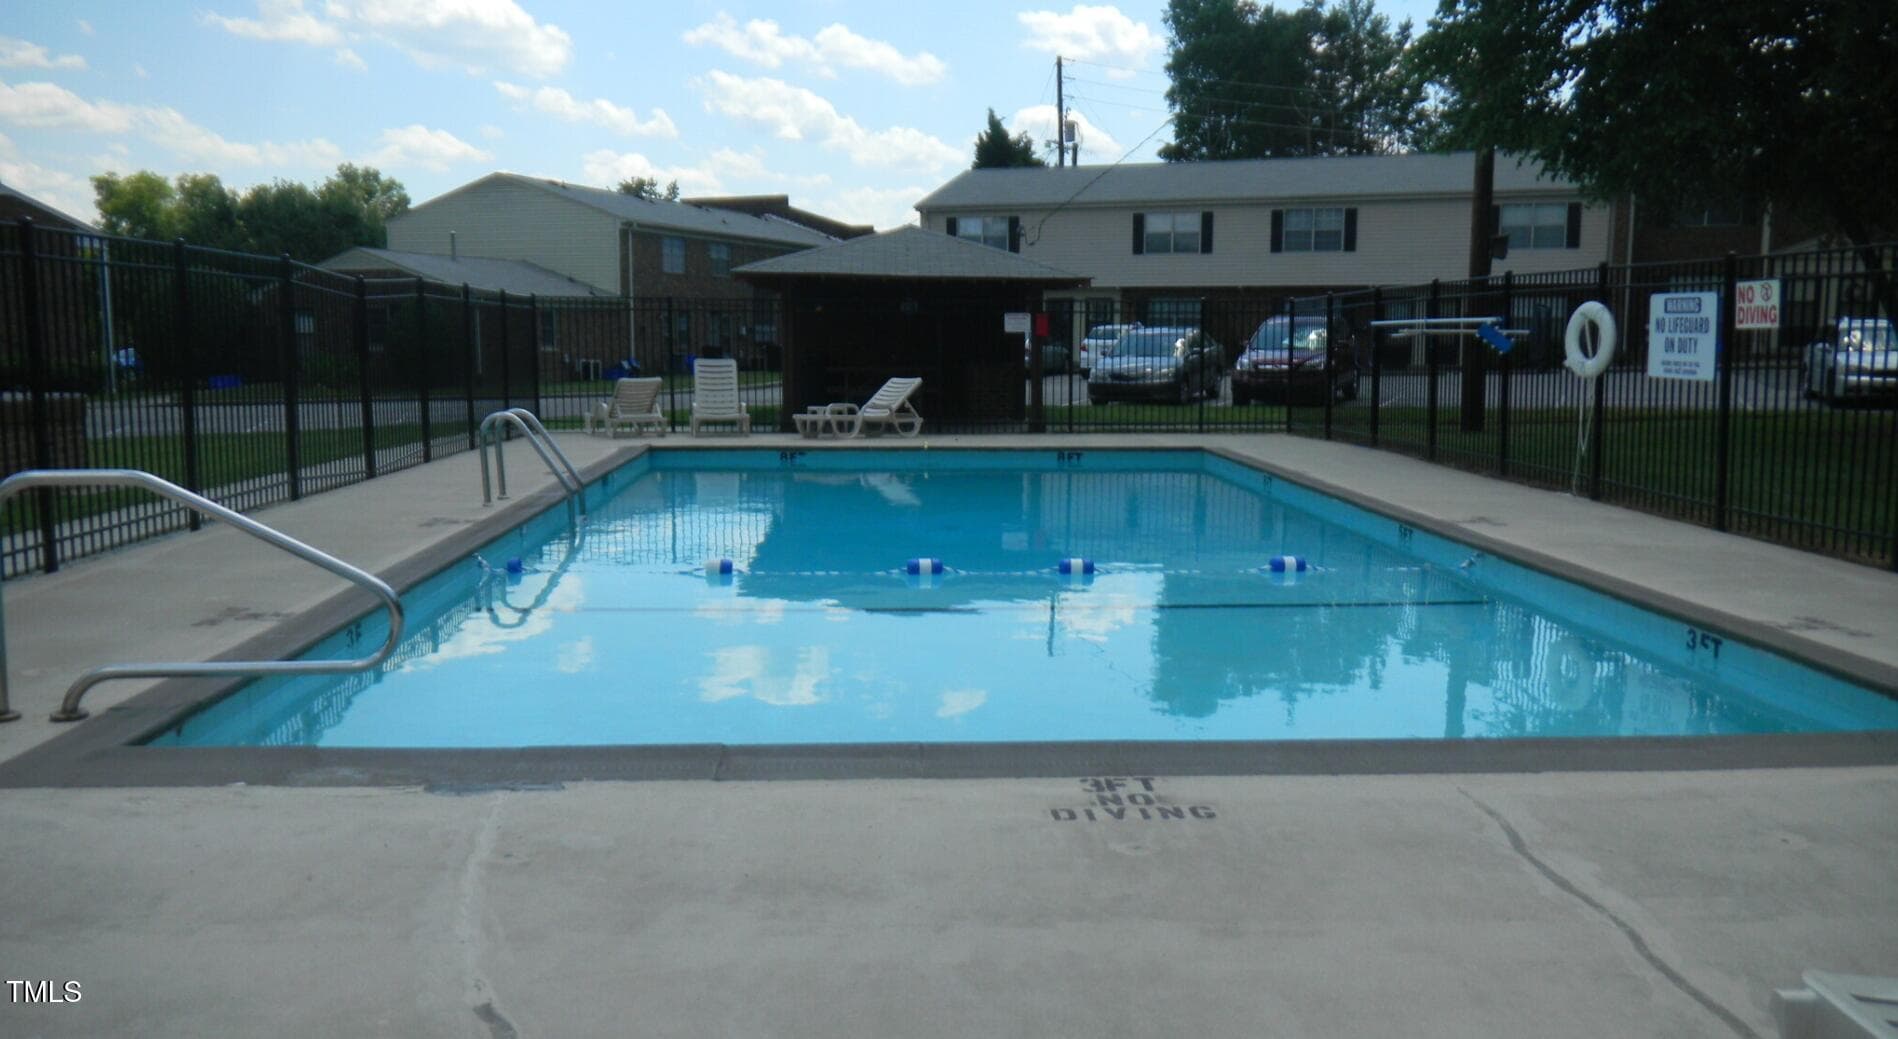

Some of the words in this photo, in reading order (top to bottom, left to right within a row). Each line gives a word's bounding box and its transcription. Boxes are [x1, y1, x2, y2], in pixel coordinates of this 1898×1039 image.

[1738, 285, 1754, 304] NO
[1738, 304, 1777, 324] DIVING
[1656, 317, 1666, 333] NO
[1668, 317, 1710, 333] LIFEGUARD
[1665, 337, 1675, 353] ON
[1678, 337, 1698, 354] DUTY
[1079, 776, 1155, 793] 3FT
[1094, 793, 1156, 807] NO
[1050, 805, 1217, 822] DIVING
